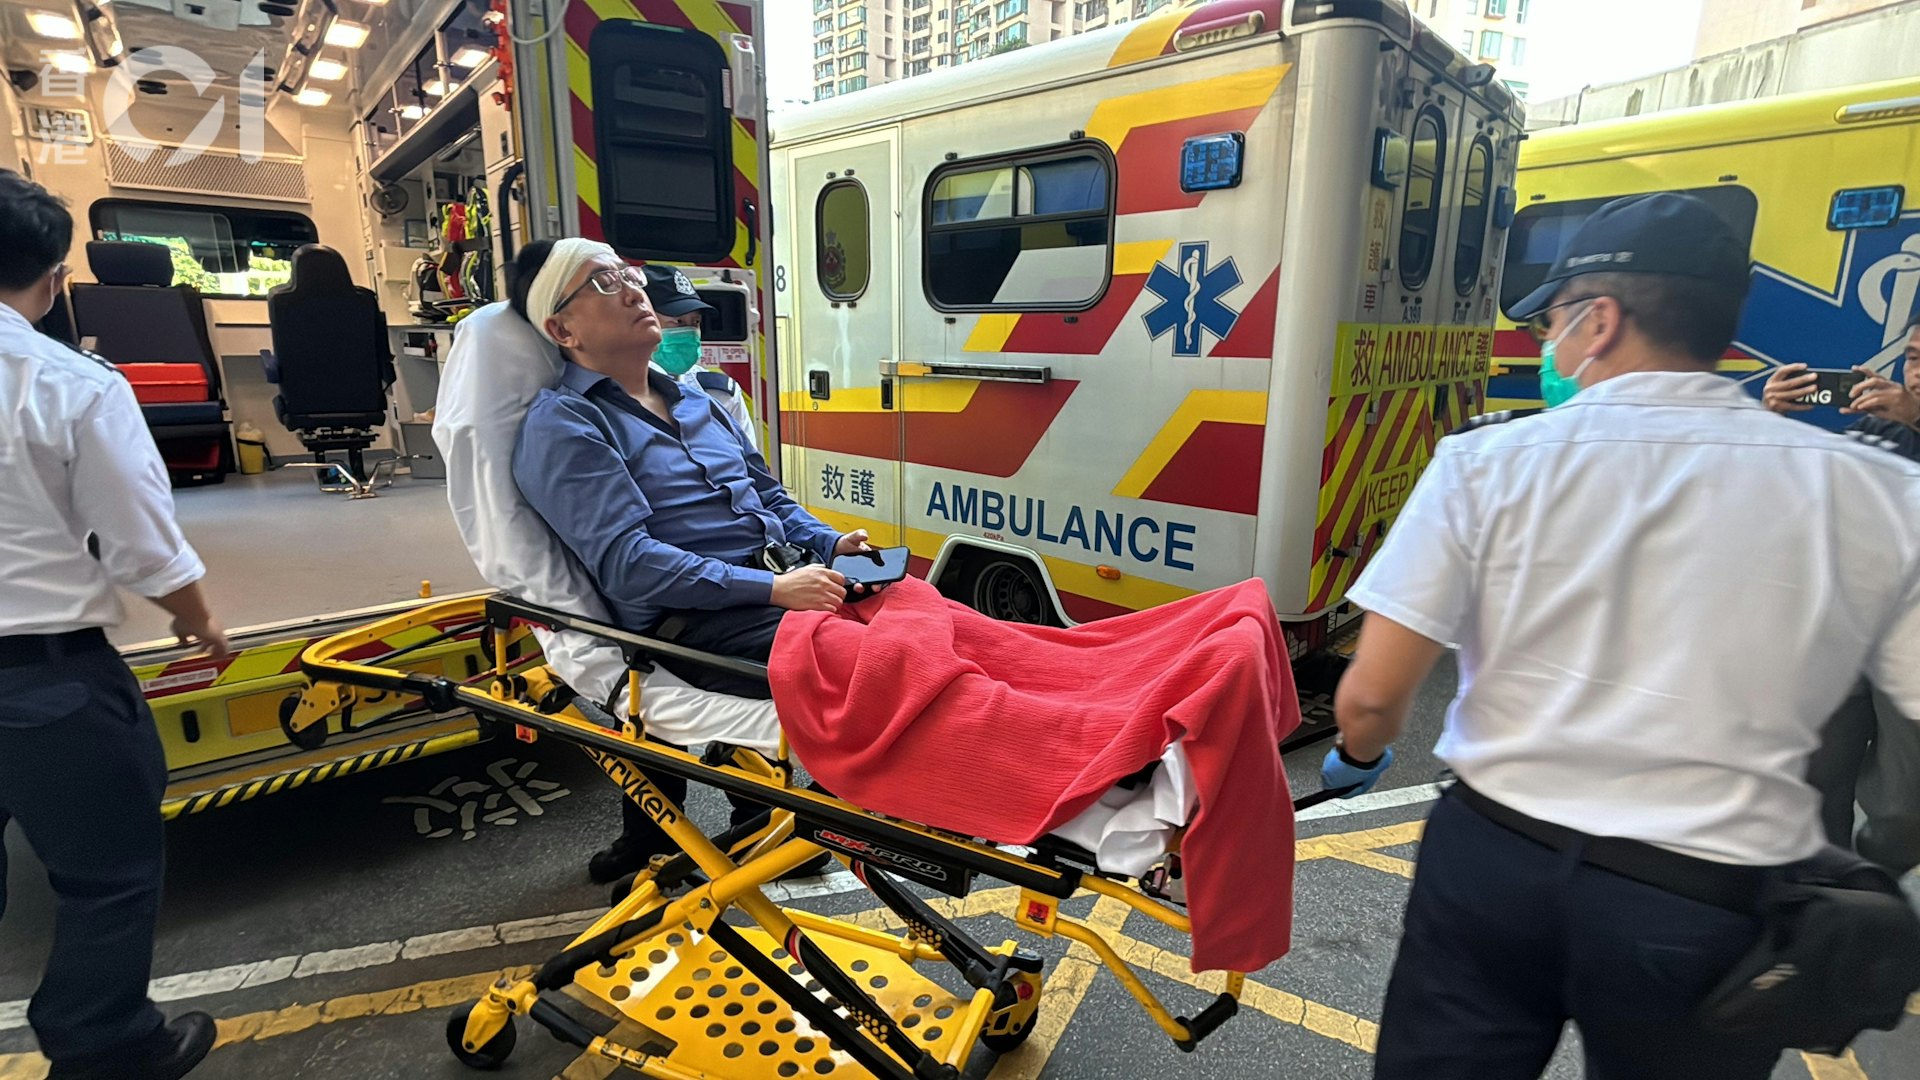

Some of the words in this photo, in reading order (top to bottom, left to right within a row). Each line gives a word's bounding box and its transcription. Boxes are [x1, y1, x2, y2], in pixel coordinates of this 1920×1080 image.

[1351, 329, 1376, 387] 救
[1378, 330, 1475, 386] AMBULANCE
[821, 464, 876, 508] 救護
[1366, 471, 1409, 517] KEEP
[927, 481, 1196, 572] AMBULANCE
